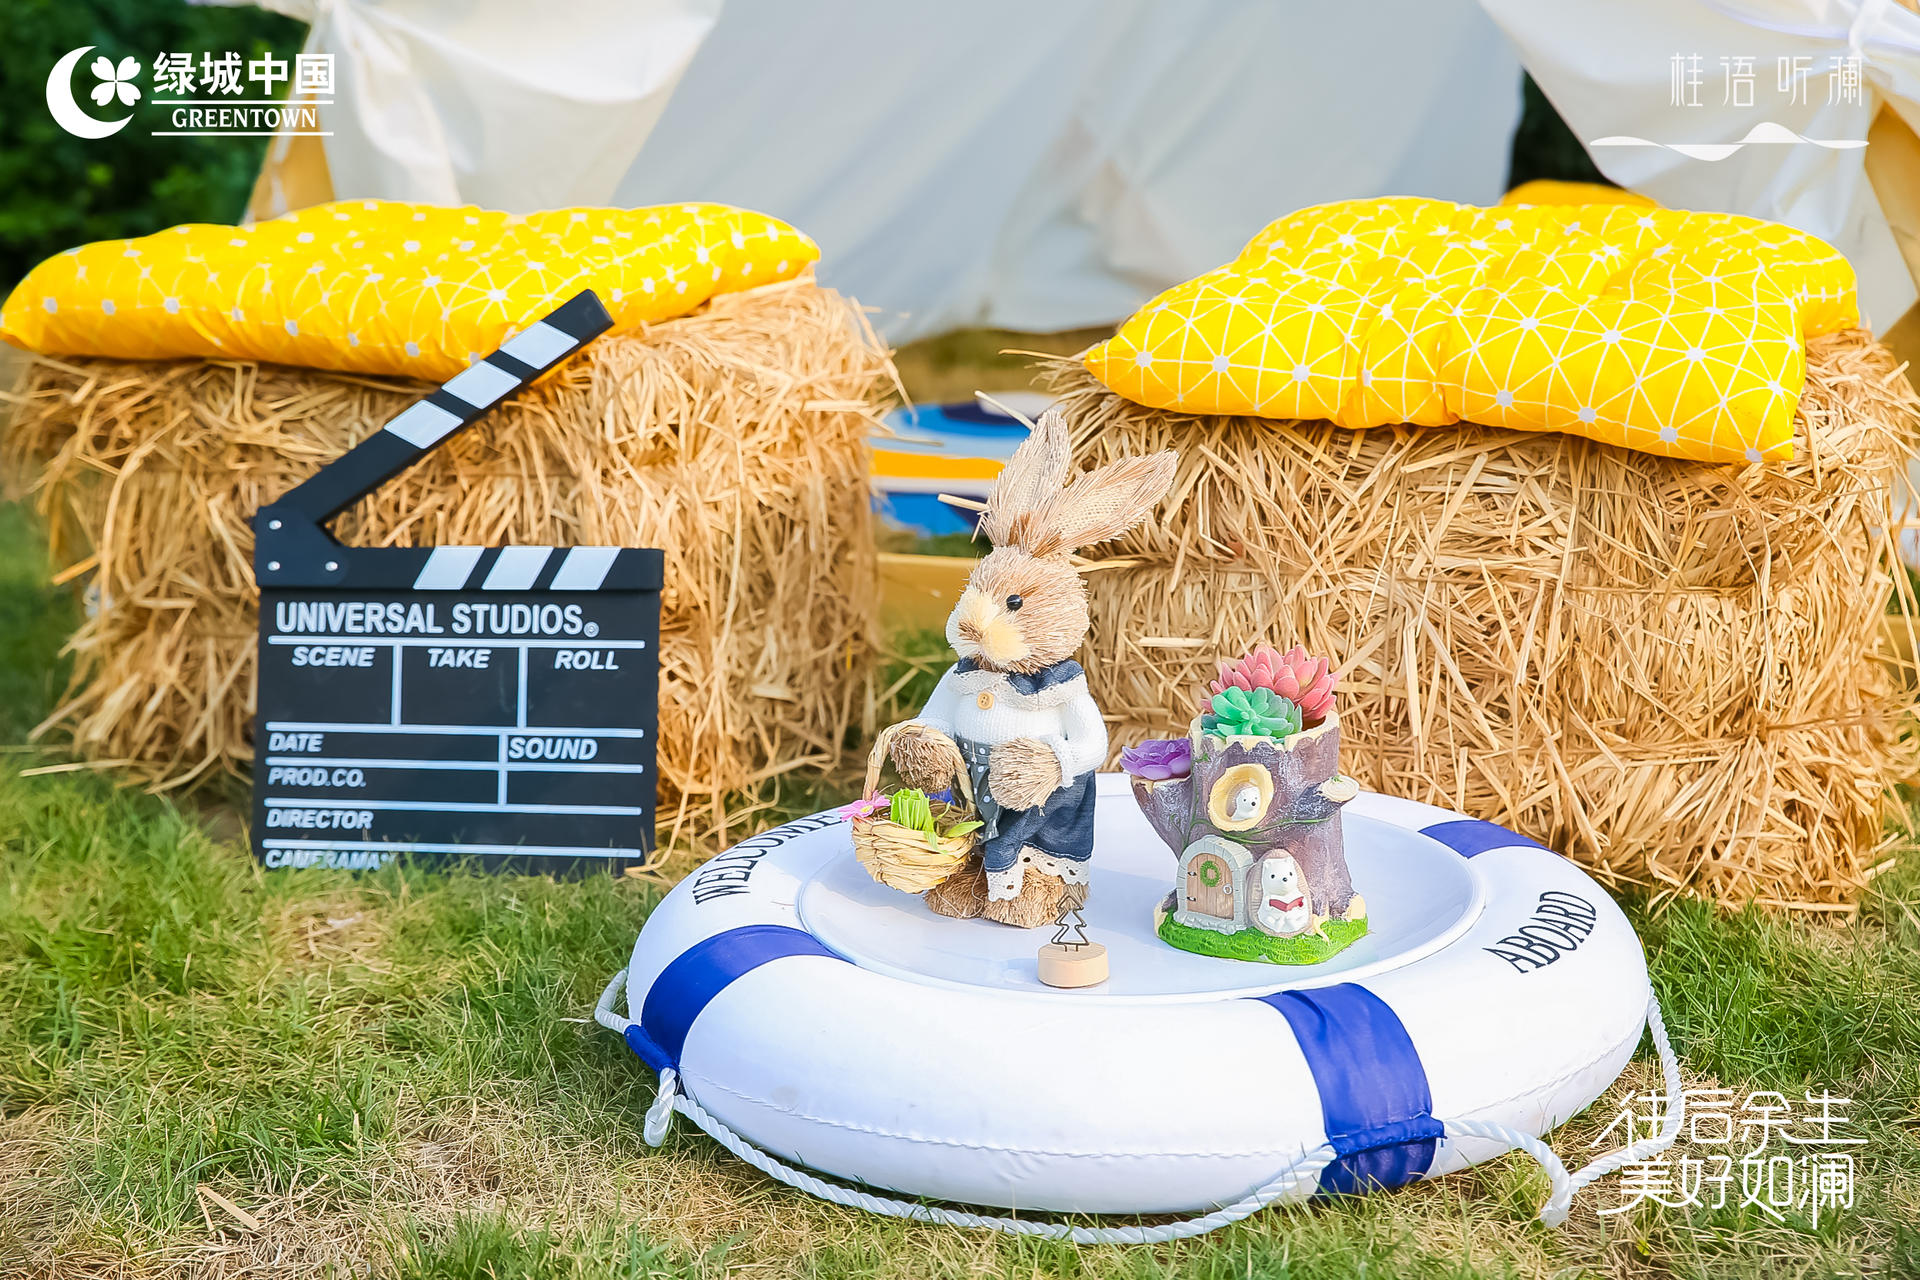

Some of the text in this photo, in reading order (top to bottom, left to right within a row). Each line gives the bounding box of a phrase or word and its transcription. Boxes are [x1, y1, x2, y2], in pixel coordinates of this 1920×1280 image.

[276, 602, 444, 635] UNIVERSAL
[292, 647, 375, 668] SCENE
[428, 648, 491, 669] TAKE
[554, 650, 619, 670] ROLL
[268, 733, 324, 752] DATE
[508, 737, 598, 760] SOUND
[268, 768, 366, 787] PROD.CO.
[266, 810, 374, 829] DIRECTOR
[692, 814, 847, 905] WELCOME
[1482, 891, 1596, 973] ABOARD
